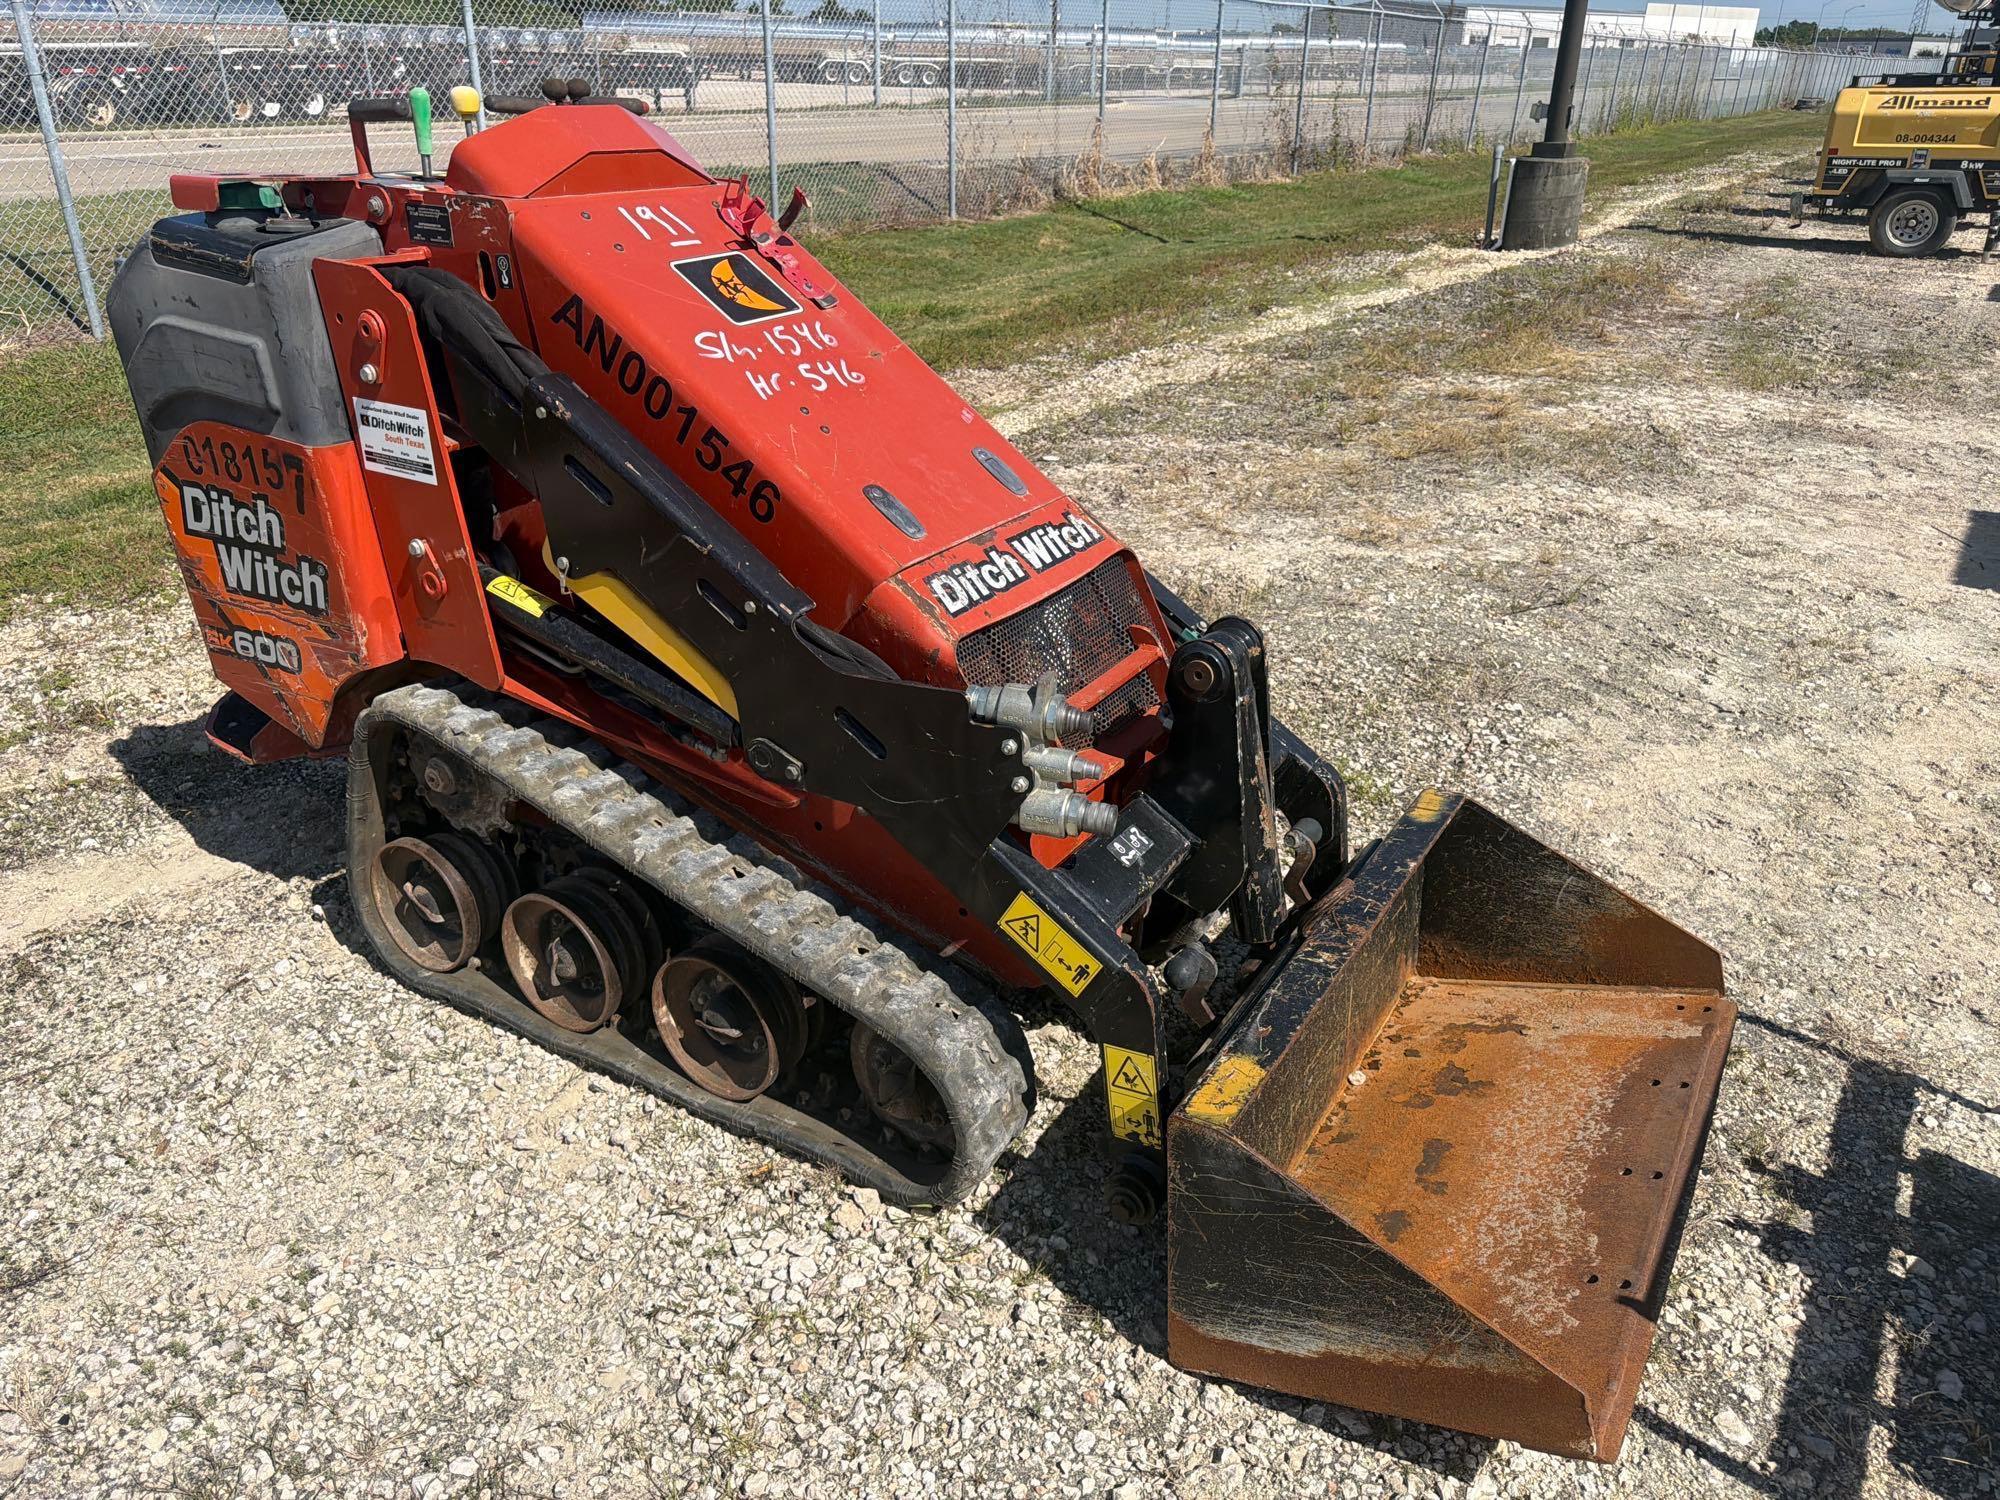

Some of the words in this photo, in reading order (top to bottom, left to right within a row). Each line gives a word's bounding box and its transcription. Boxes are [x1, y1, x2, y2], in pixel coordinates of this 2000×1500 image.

[1878, 96, 1991, 110] Allmand
[1895, 134, 1956, 143] 08-004344
[1960, 161, 1968, 169] 8
[618, 206, 697, 242] 191
[764, 321, 838, 356] 1546
[798, 360, 866, 391] 546
[551, 293, 781, 523] AN001546
[385, 433, 404, 445] South
[405, 438, 425, 449] Texas
[182, 486, 281, 549] Ditch
[217, 543, 326, 609] Witch
[930, 550, 1025, 613] Ditch
[1010, 512, 1100, 570] Witch
[233, 629, 298, 669] 600
